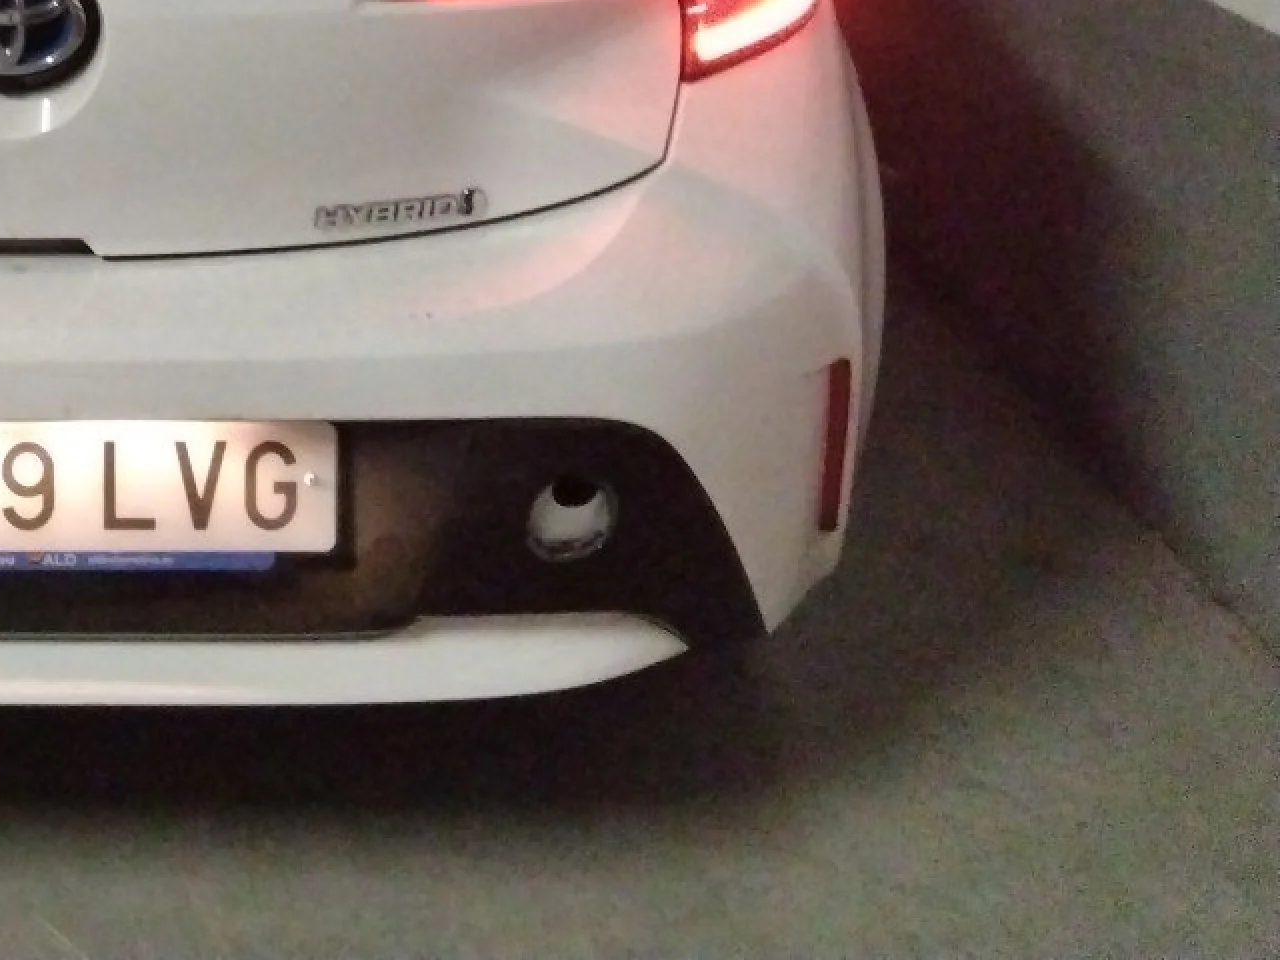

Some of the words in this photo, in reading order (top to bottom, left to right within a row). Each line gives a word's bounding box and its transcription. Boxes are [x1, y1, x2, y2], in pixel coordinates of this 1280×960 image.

[314, 194, 459, 231] HYBRID
[102, 440, 299, 531] LVG
[41, 553, 77, 566] ALD
